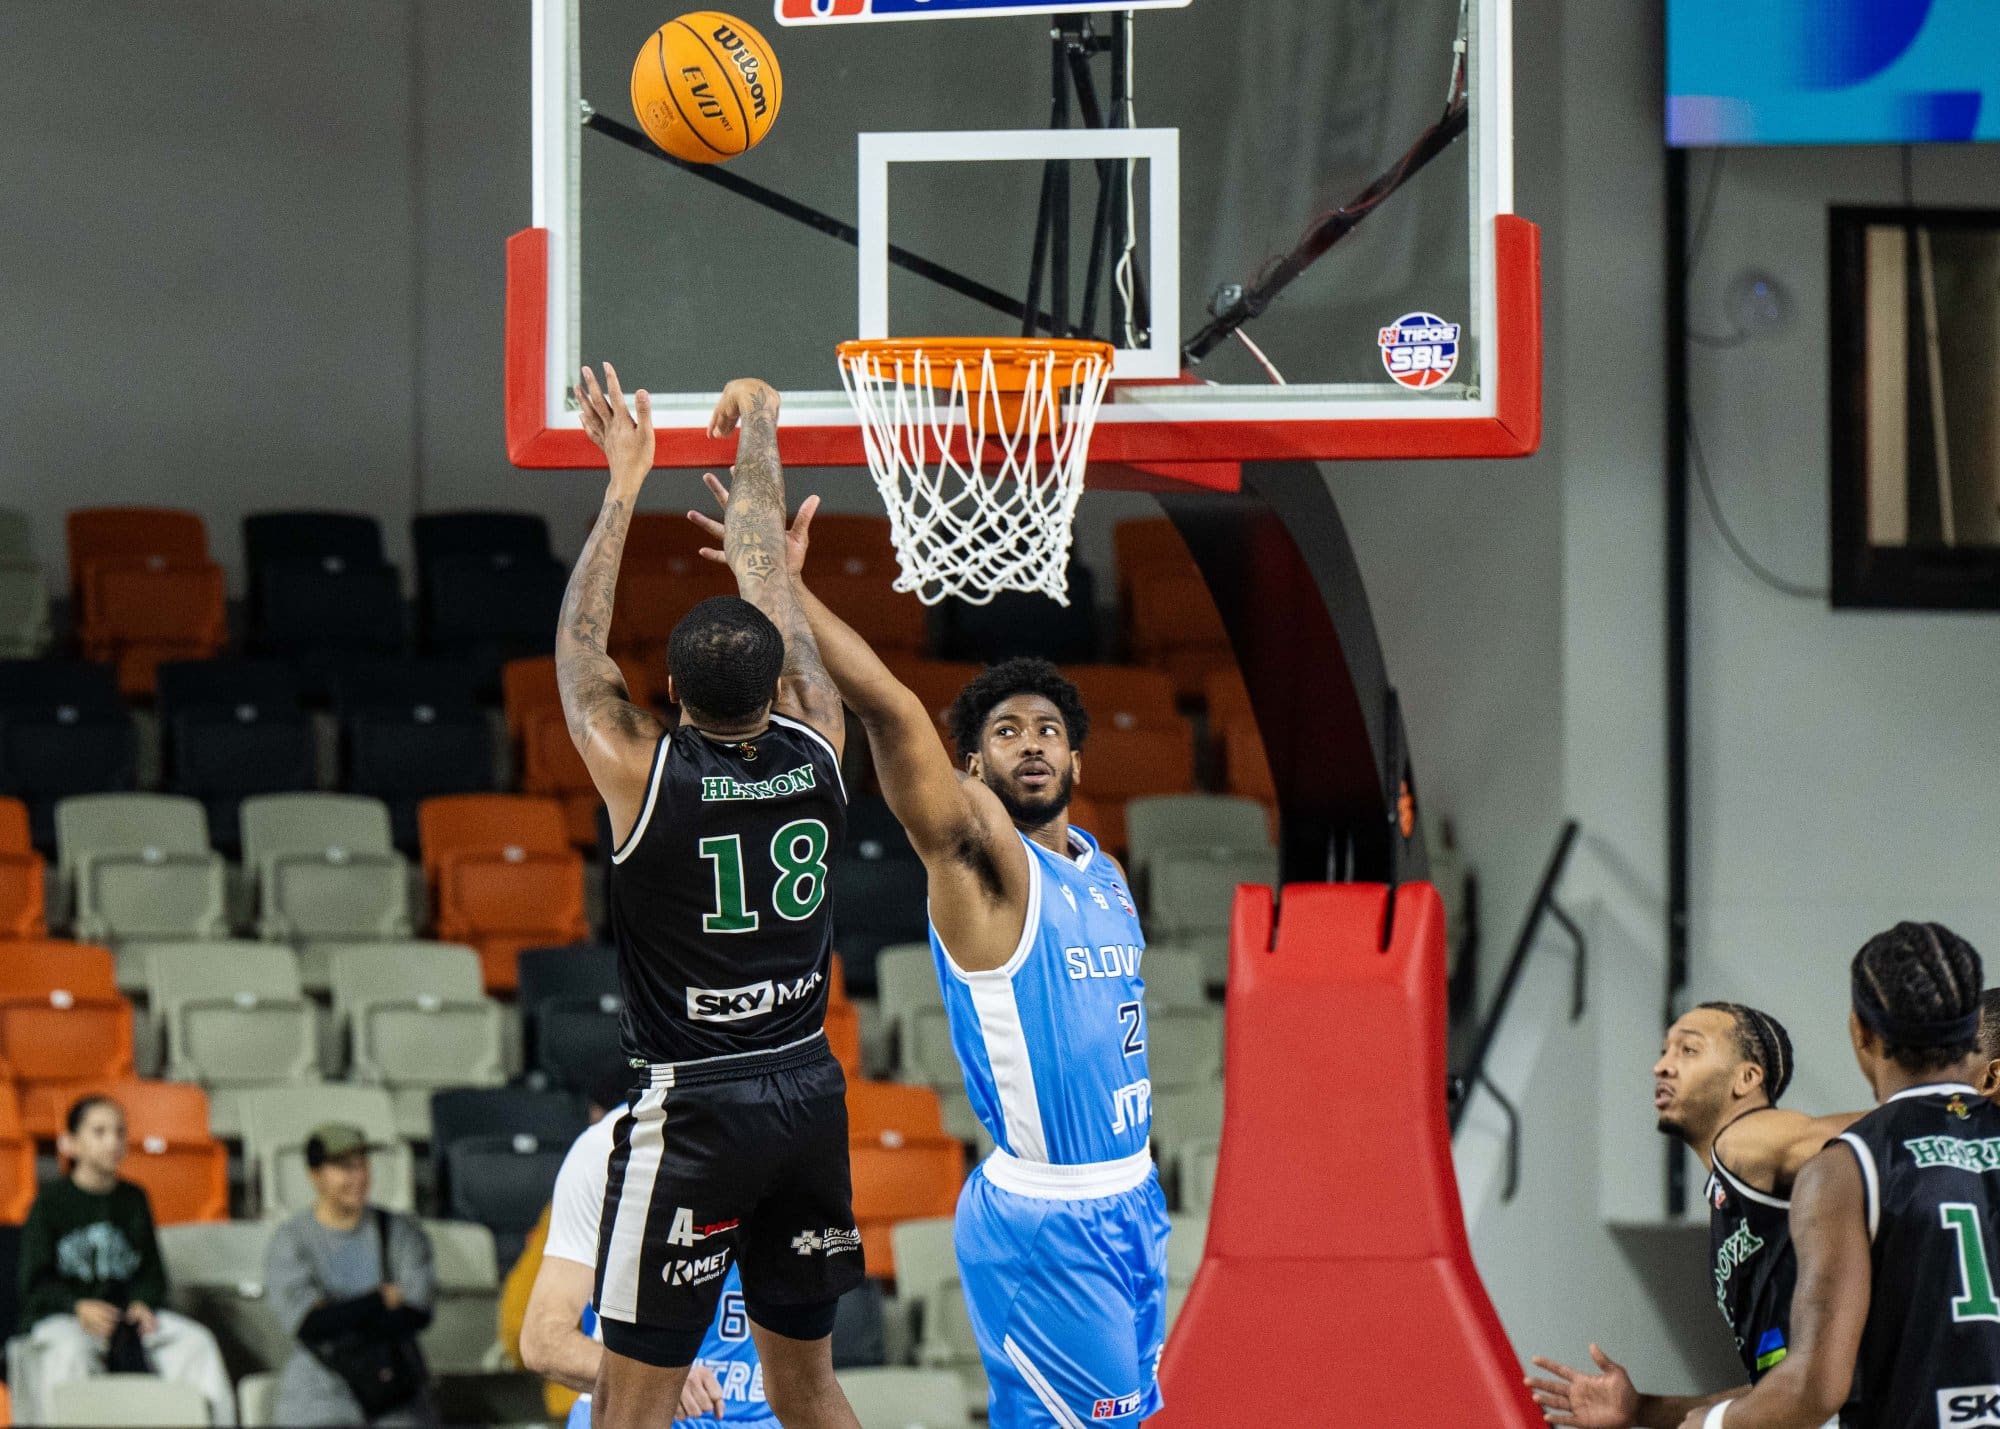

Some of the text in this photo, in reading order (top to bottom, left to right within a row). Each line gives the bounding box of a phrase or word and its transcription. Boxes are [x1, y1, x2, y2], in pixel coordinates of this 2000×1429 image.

[682, 66, 724, 119] EVO
[712, 24, 768, 121] Wilson
[1389, 345, 1452, 371] SBL
[1401, 326, 1456, 342] TIPOS
[699, 818, 829, 934] 18
[1065, 944, 1142, 980] SLOV
[695, 987, 767, 1016] SKY
[1118, 1001, 1145, 1057] 2
[1111, 1078, 1152, 1135] JTR
[1939, 1203, 2000, 1322] 1
[718, 1290, 751, 1342] 6
[692, 1358, 767, 1403] TRE
